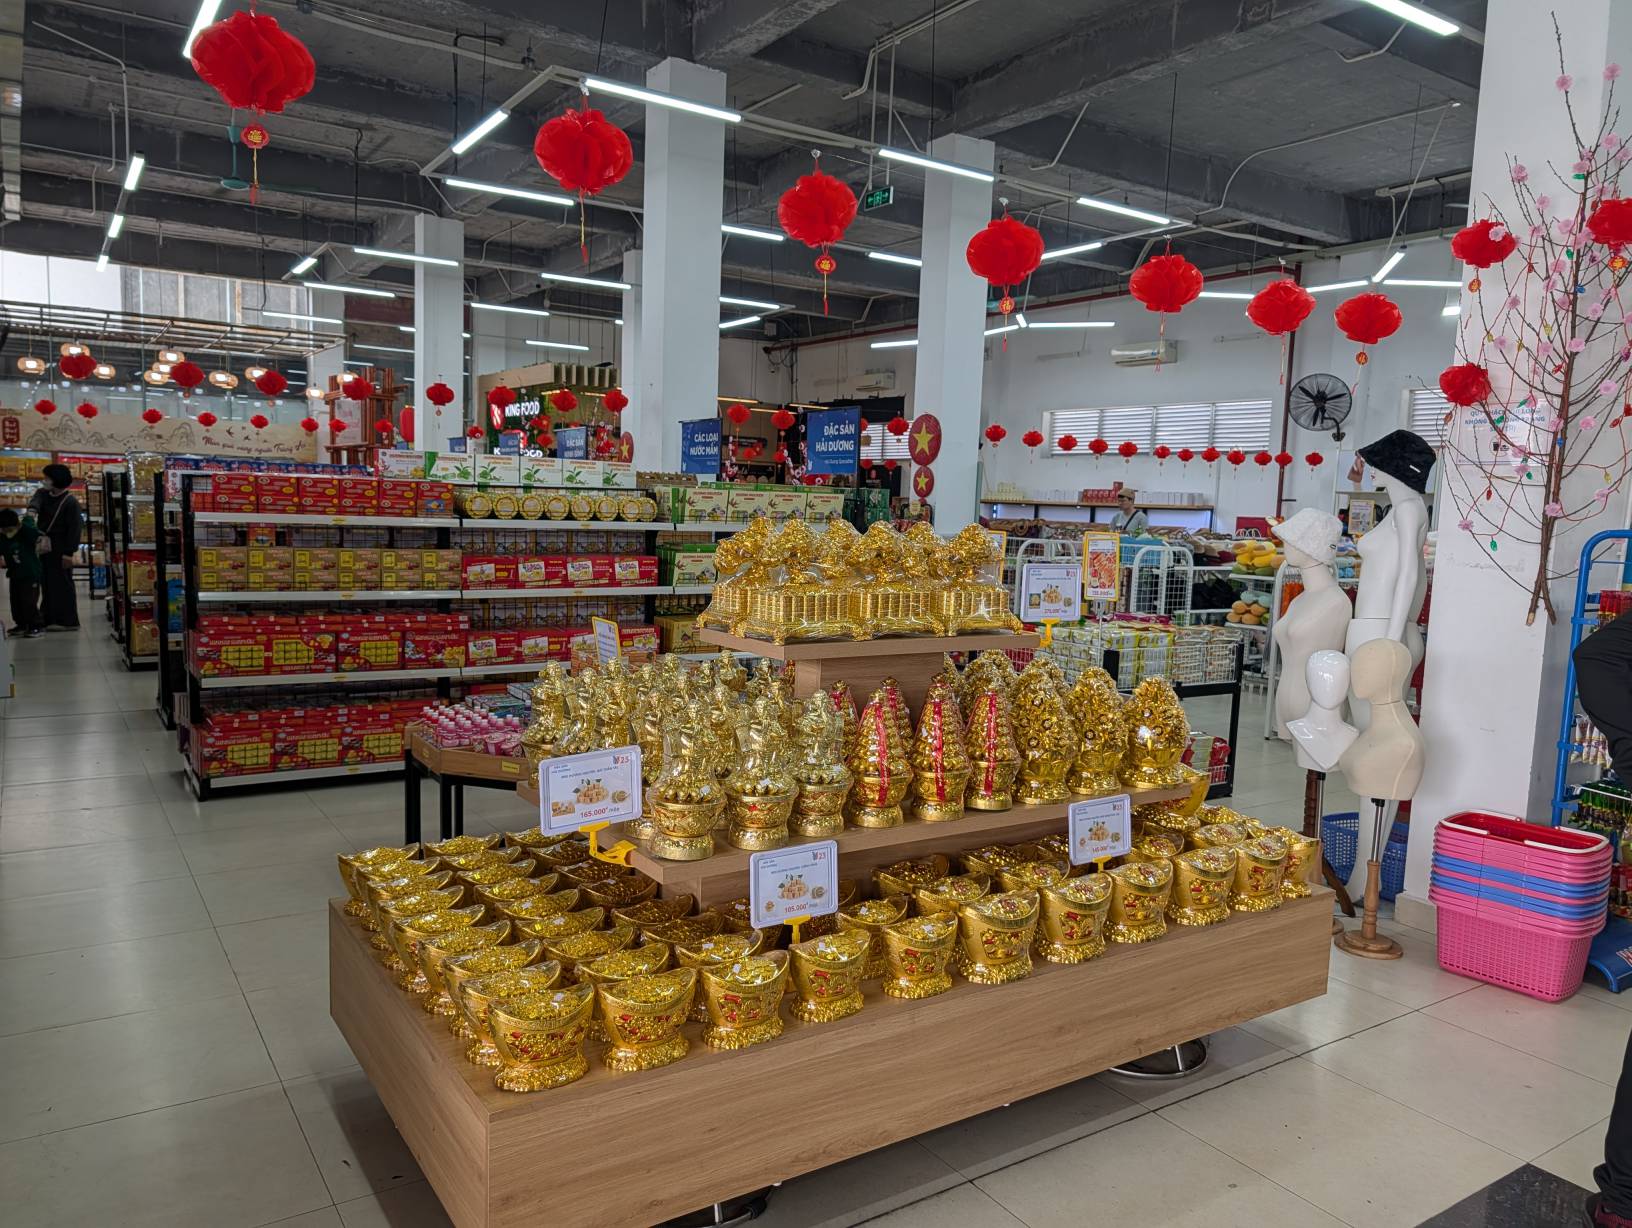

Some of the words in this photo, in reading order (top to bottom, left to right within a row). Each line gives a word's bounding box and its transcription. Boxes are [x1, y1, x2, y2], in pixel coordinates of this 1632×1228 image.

[505, 403, 521, 417] KING
[521, 401, 540, 416] FOOD
[823, 421, 839, 438] ĐẶC
[840, 419, 855, 435] SẢN
[694, 431, 706, 442] CÁC
[706, 432, 719, 442] LOẠI
[690, 444, 705, 455] NƯỚC
[706, 441, 719, 455] MẮM
[815, 437, 828, 452] HẢI
[828, 439, 854, 451] DƯƠNG
